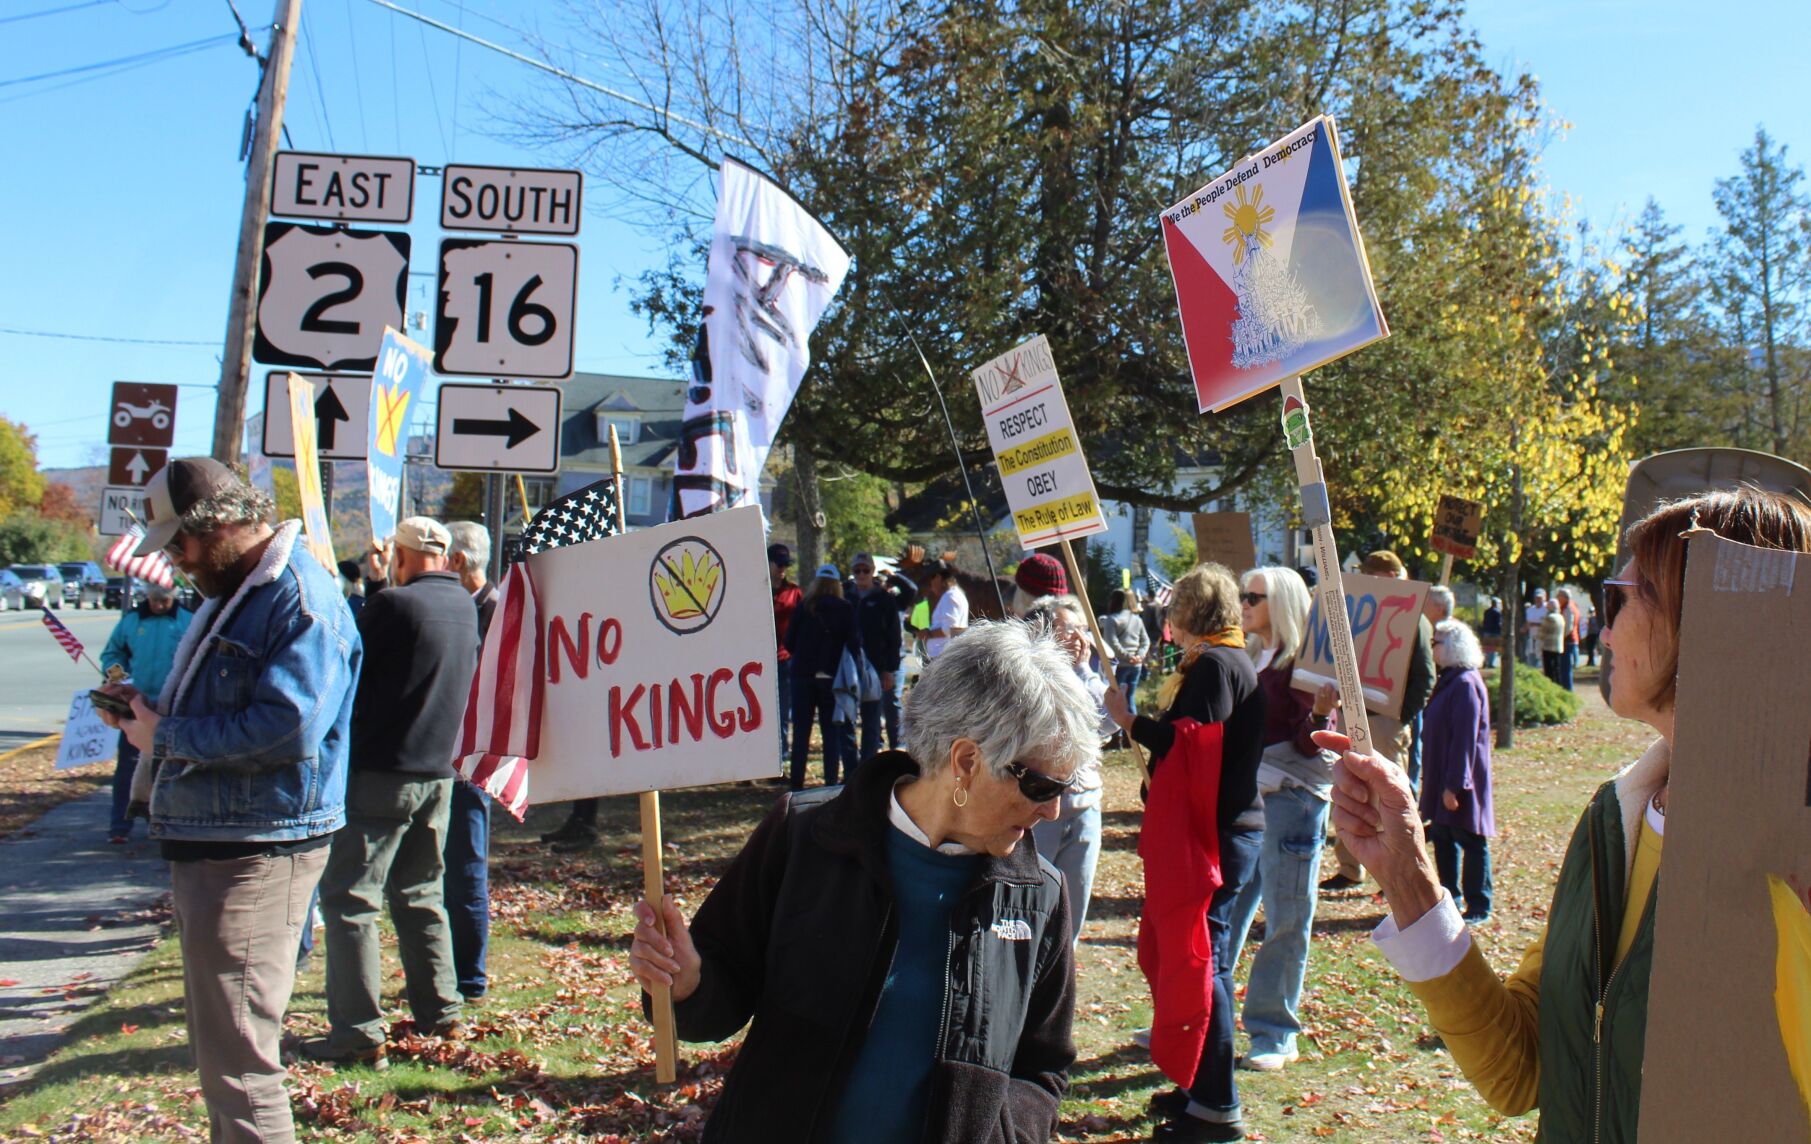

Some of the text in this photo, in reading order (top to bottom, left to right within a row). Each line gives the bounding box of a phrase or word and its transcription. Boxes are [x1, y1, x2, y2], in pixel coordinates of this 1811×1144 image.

[295, 164, 392, 209] EAST
[1167, 128, 1320, 225] We the People Defend Democracy
[448, 176, 572, 225] SOUTH
[300, 261, 364, 335] 2
[473, 272, 557, 346] 16
[382, 347, 409, 384] NO
[978, 341, 1054, 406] NO KINGS
[1000, 403, 1048, 440] RESPECT
[999, 434, 1073, 472] The Constitution
[107, 495, 128, 511] NO
[1027, 470, 1058, 497] OBEY
[1018, 499, 1092, 532] The Rule of Law
[547, 612, 622, 685] NO
[609, 661, 763, 758] KINGS
